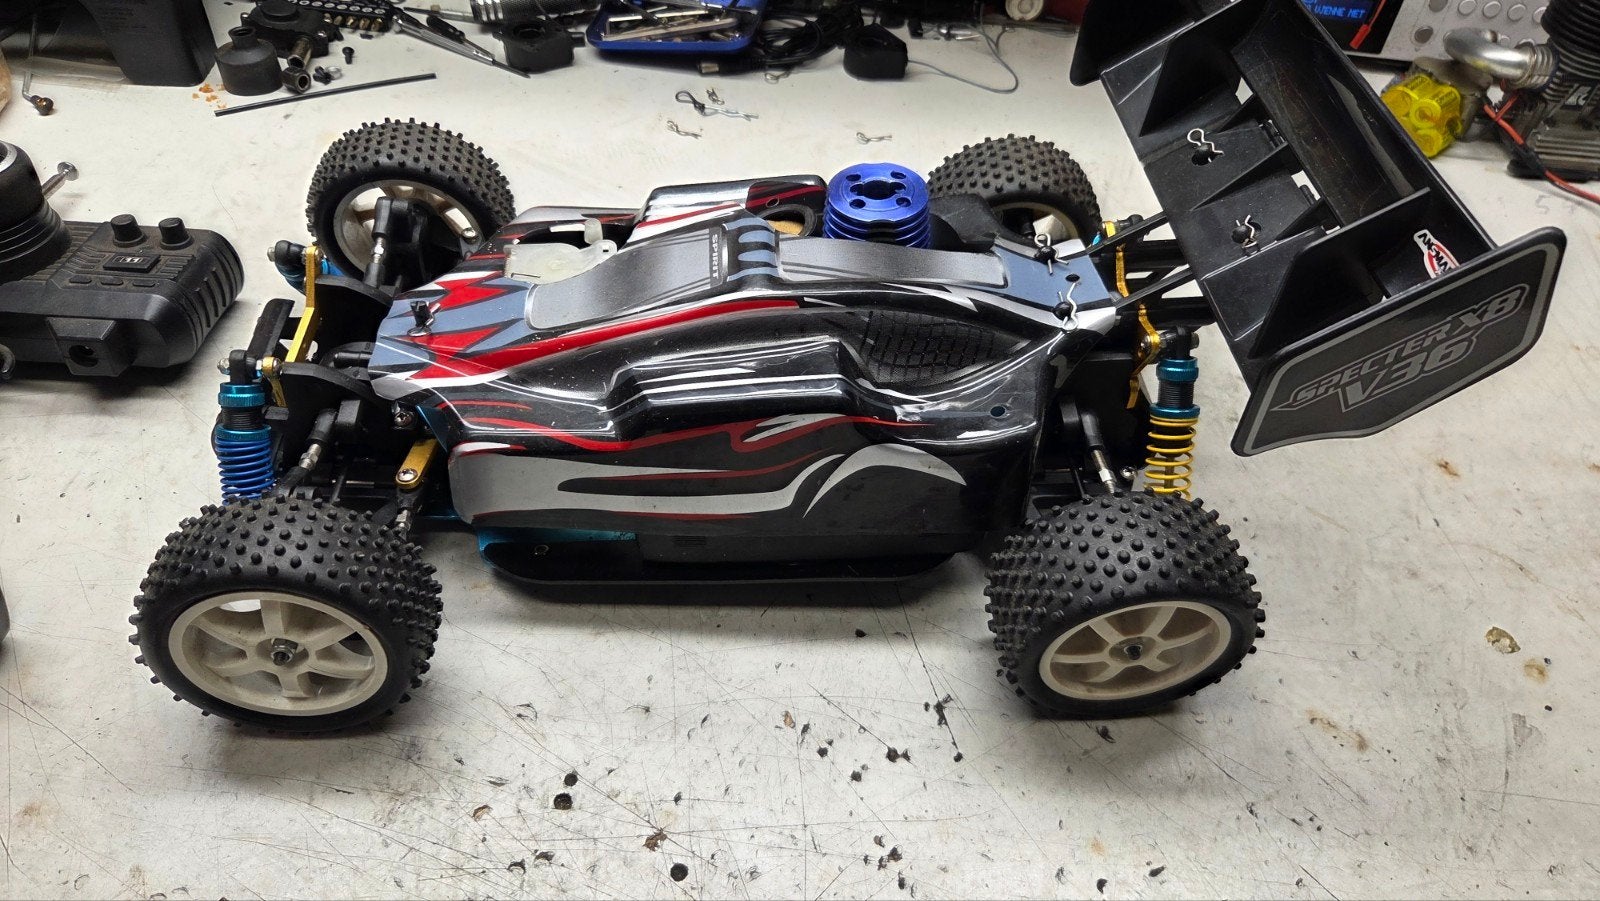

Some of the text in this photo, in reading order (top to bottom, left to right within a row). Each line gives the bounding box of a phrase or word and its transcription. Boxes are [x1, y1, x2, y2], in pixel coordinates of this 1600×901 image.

[711, 233, 719, 280] SPIRIT
[1292, 289, 1522, 406] SPECTER X8
[1345, 329, 1475, 406] V36
